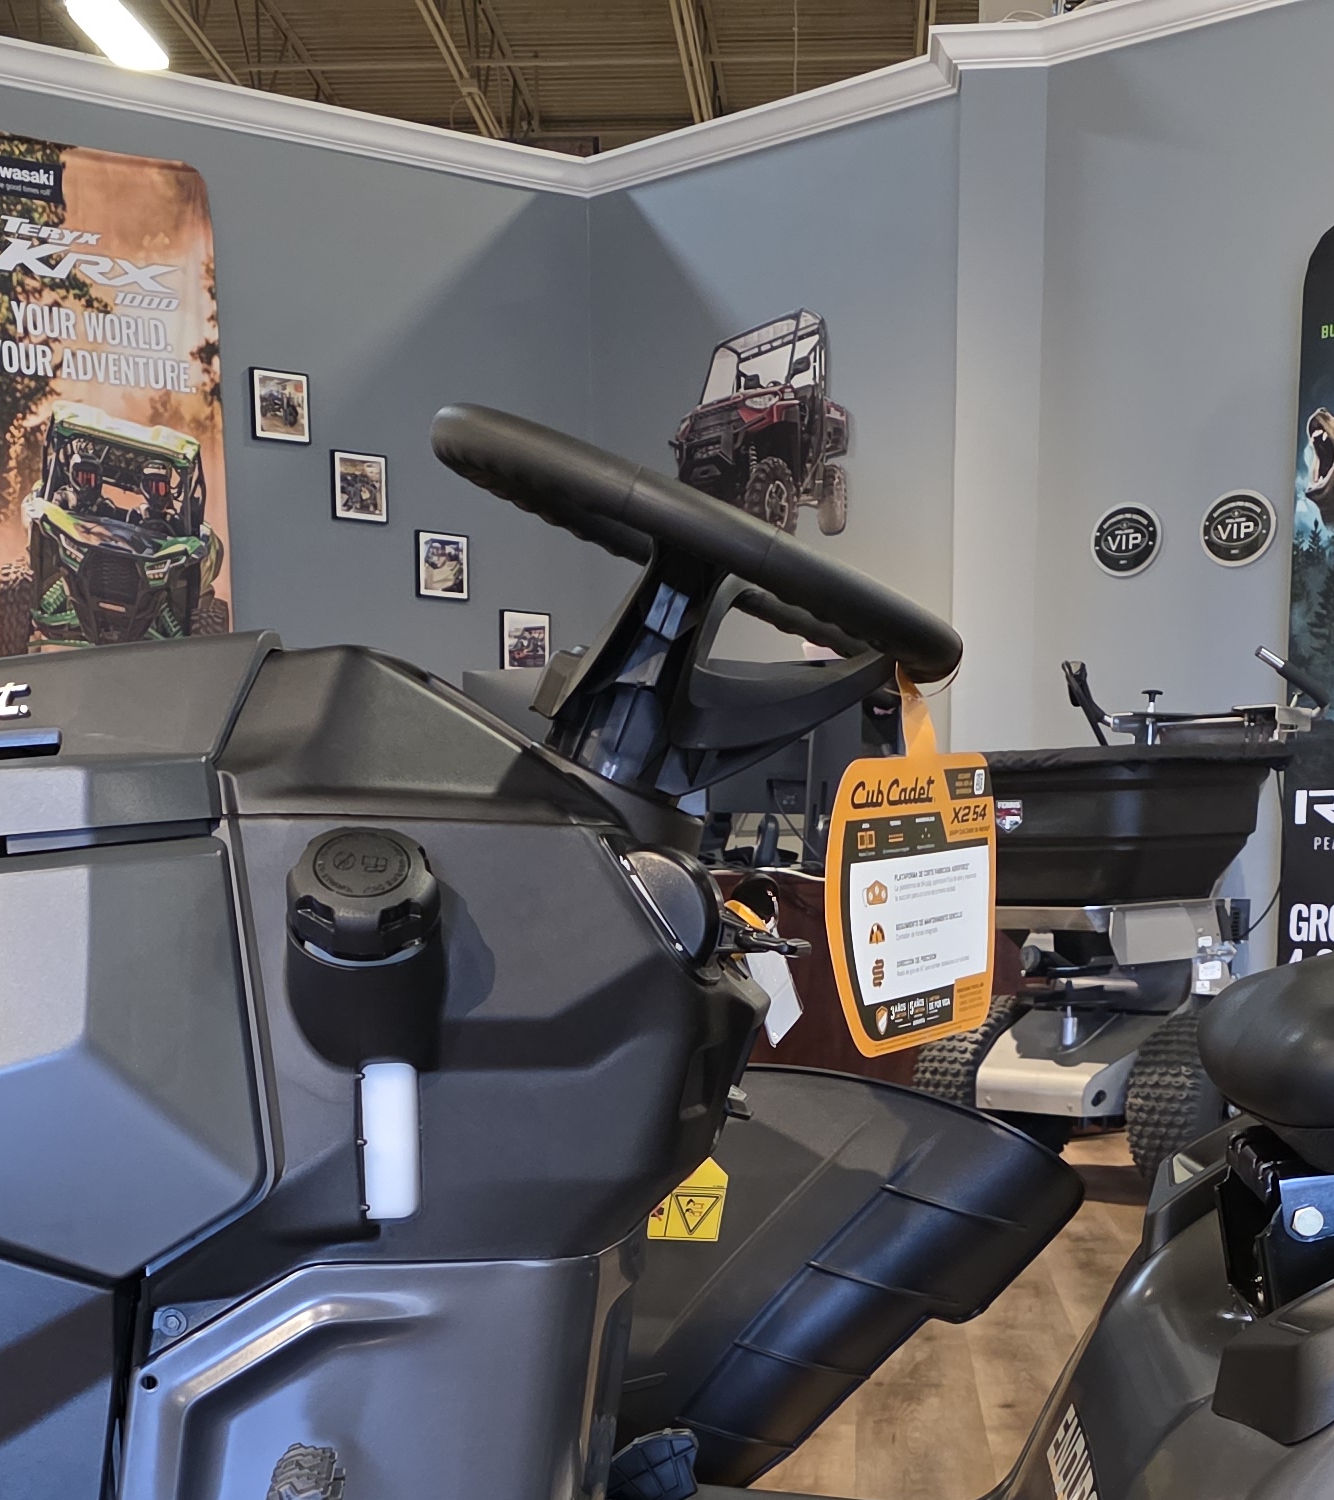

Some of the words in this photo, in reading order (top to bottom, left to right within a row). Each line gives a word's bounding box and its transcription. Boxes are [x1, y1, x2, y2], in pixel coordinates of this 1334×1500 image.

[5, 182, 22, 194] good
[0, 215, 102, 246] TERYX
[114, 291, 180, 312] 1000
[11, 300, 77, 340] YOUR
[83, 312, 173, 352] WORLD.
[61, 348, 197, 394] ADVENTURE.
[1107, 532, 1142, 551] VIP
[1217, 521, 1255, 540] VIP
[851, 779, 884, 810] Cub
[886, 776, 935, 806] Cadet
[951, 806, 971, 825] X2
[971, 803, 987, 821] 54
